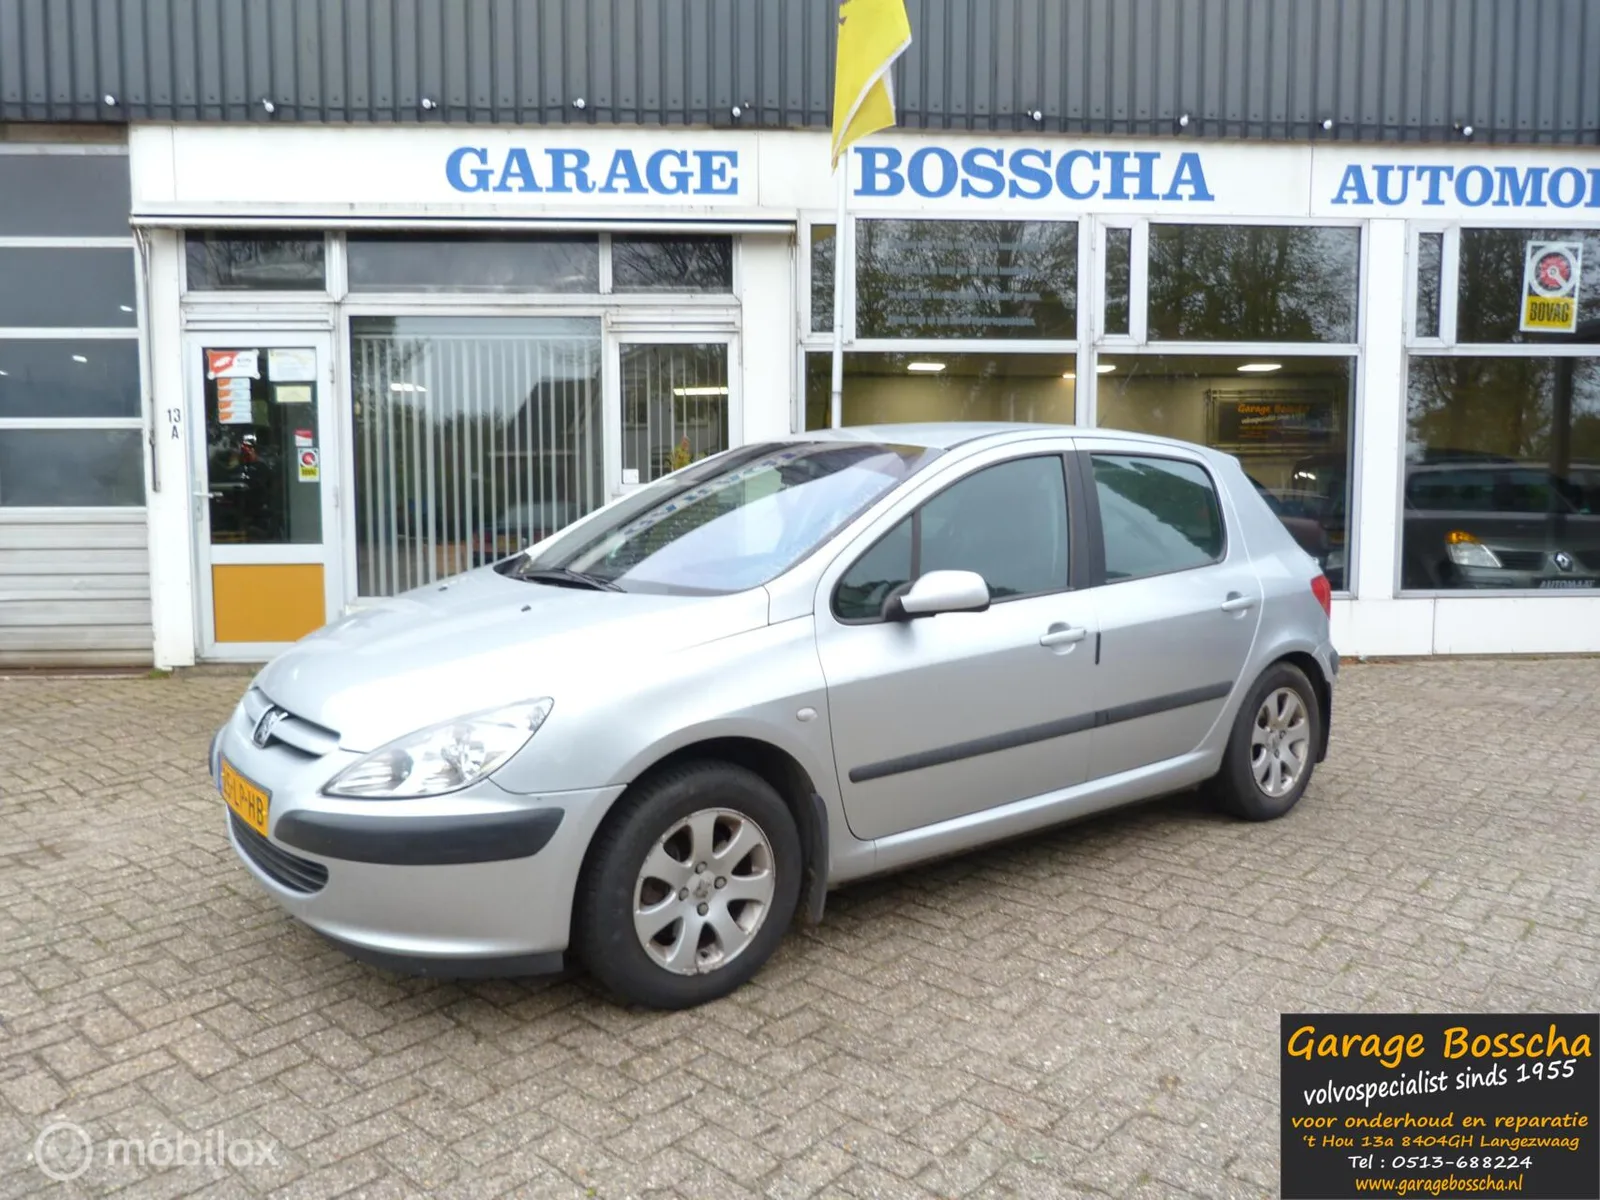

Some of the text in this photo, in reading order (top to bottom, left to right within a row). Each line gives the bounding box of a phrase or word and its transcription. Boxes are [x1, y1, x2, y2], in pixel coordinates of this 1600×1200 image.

[446, 146, 1215, 202] GARAGE BOSSCHA
[1530, 302, 1569, 322] BOVAG
[167, 408, 181, 424] 13
[171, 425, 180, 440] A
